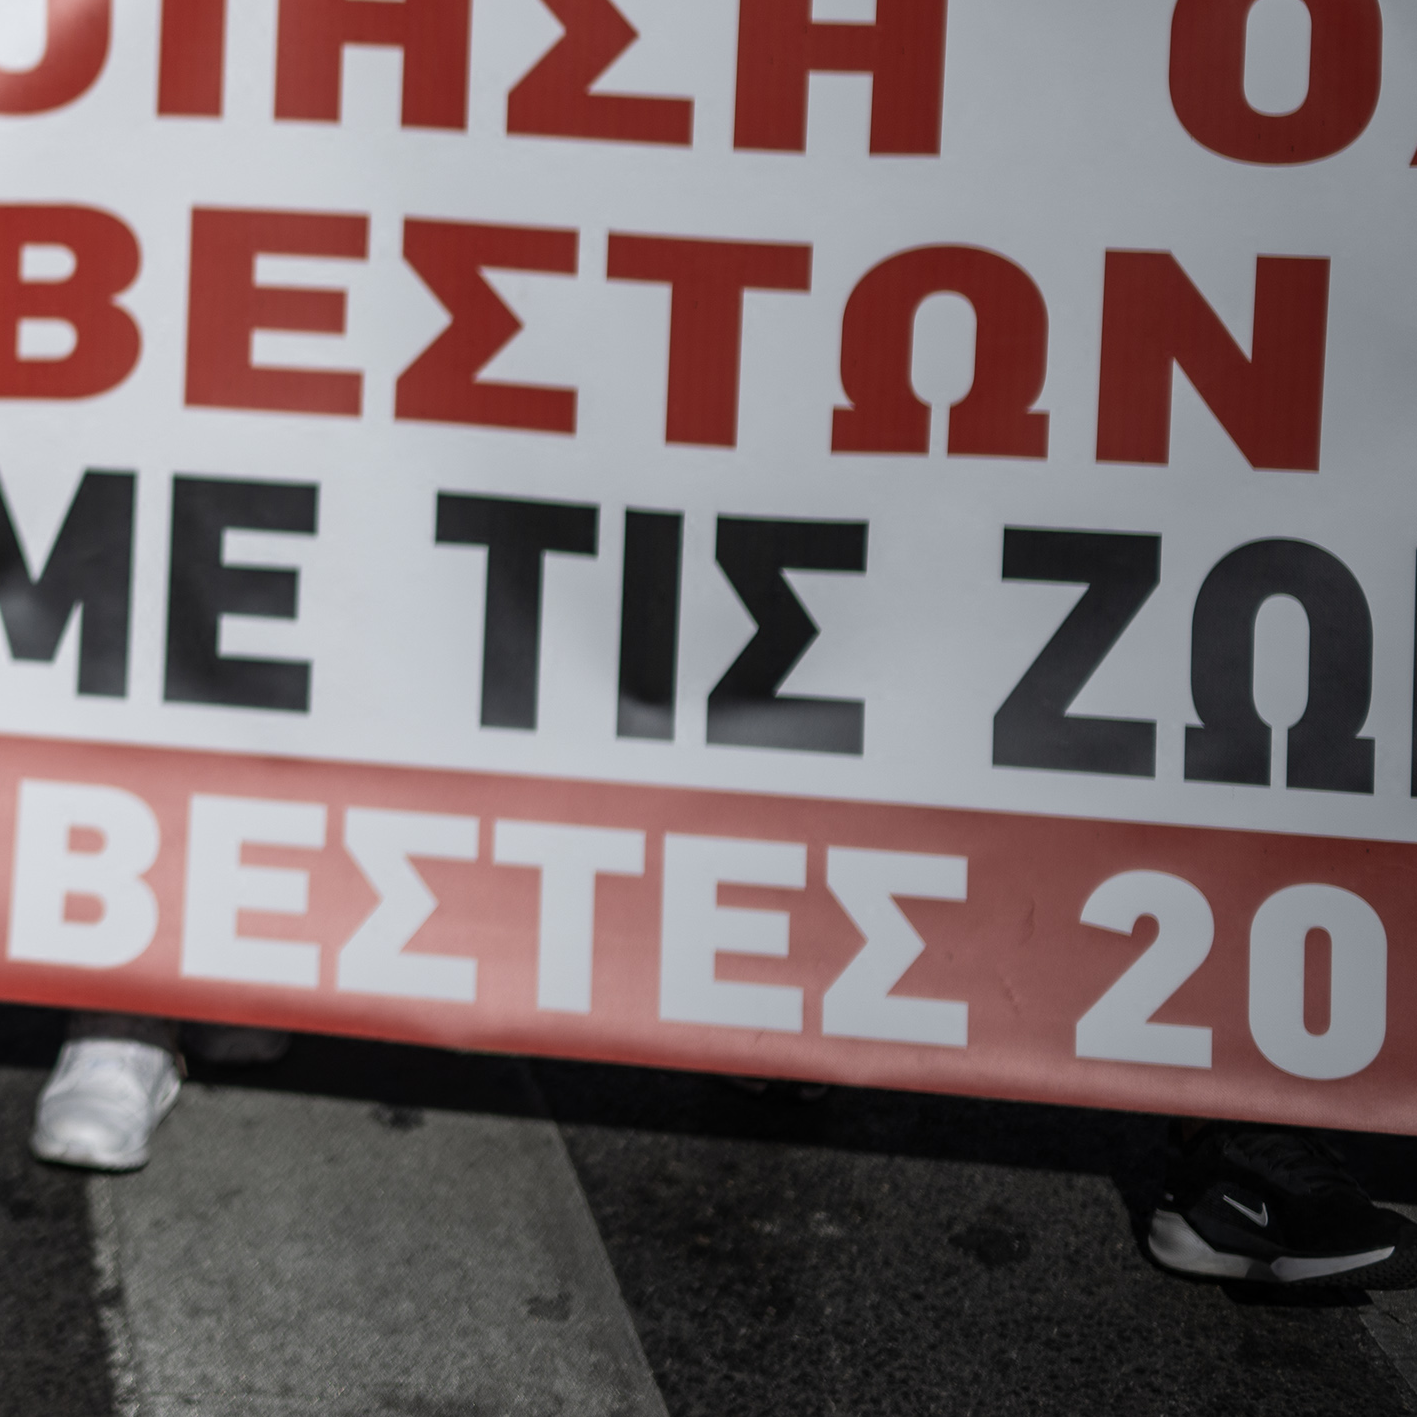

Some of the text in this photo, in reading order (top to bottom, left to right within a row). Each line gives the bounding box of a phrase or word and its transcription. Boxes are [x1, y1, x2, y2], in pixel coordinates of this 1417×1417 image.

[435, 493, 867, 754] ΤΙΣ
[992, 528, 1417, 798] ΖΩ
[1075, 869, 1387, 1082] 20
